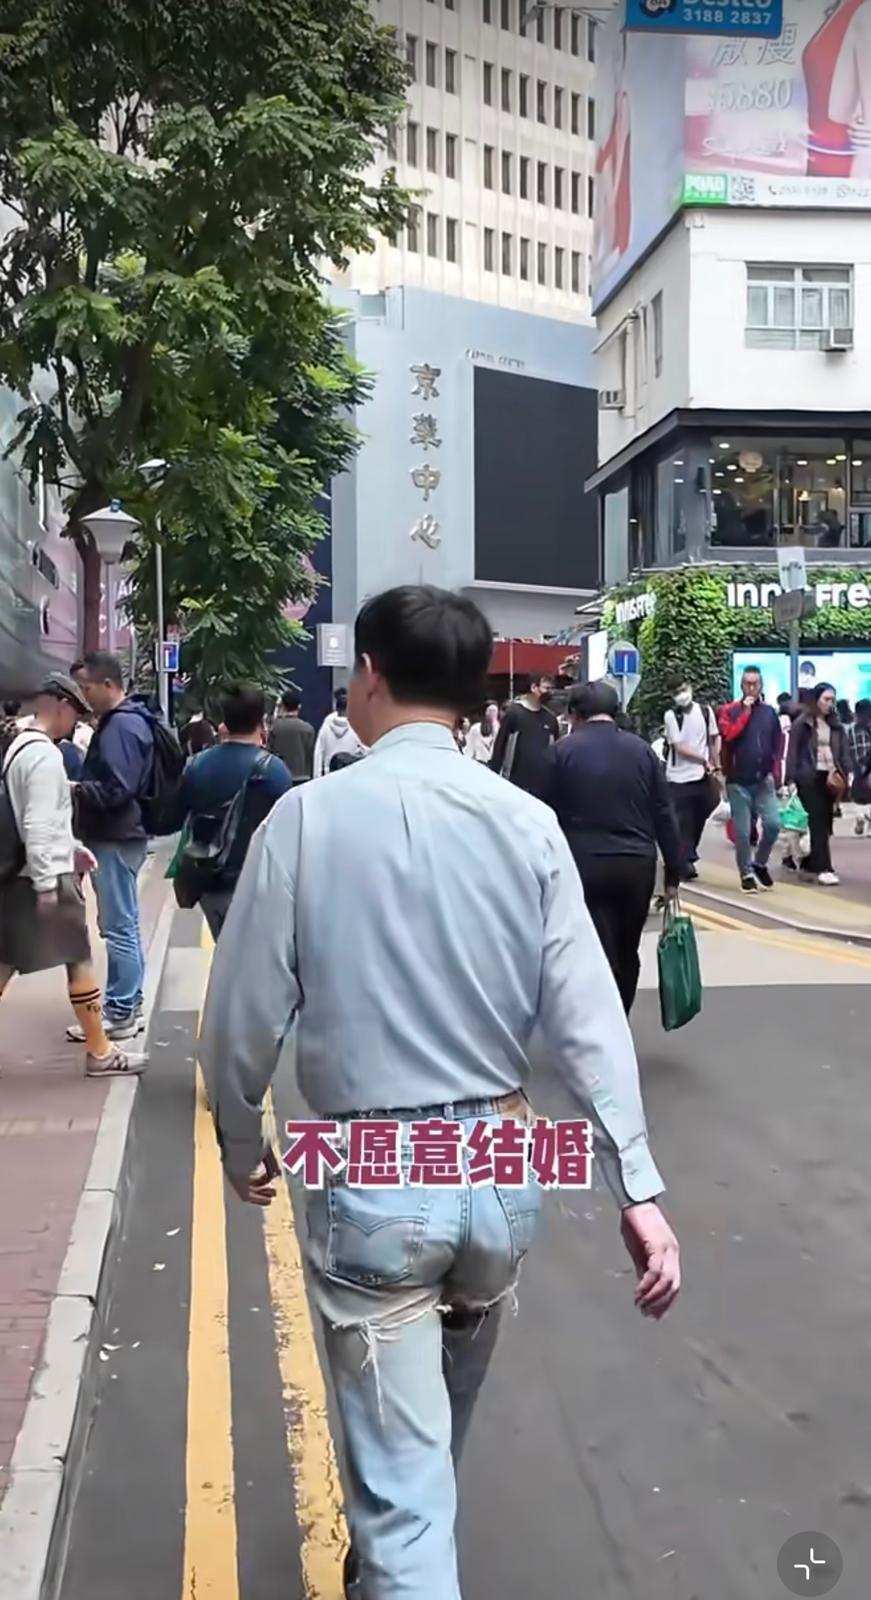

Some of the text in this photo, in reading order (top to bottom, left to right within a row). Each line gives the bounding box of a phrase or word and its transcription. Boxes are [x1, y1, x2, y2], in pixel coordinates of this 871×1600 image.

[682, 8, 724, 23] 3188
[409, 363, 442, 549] 京華中心
